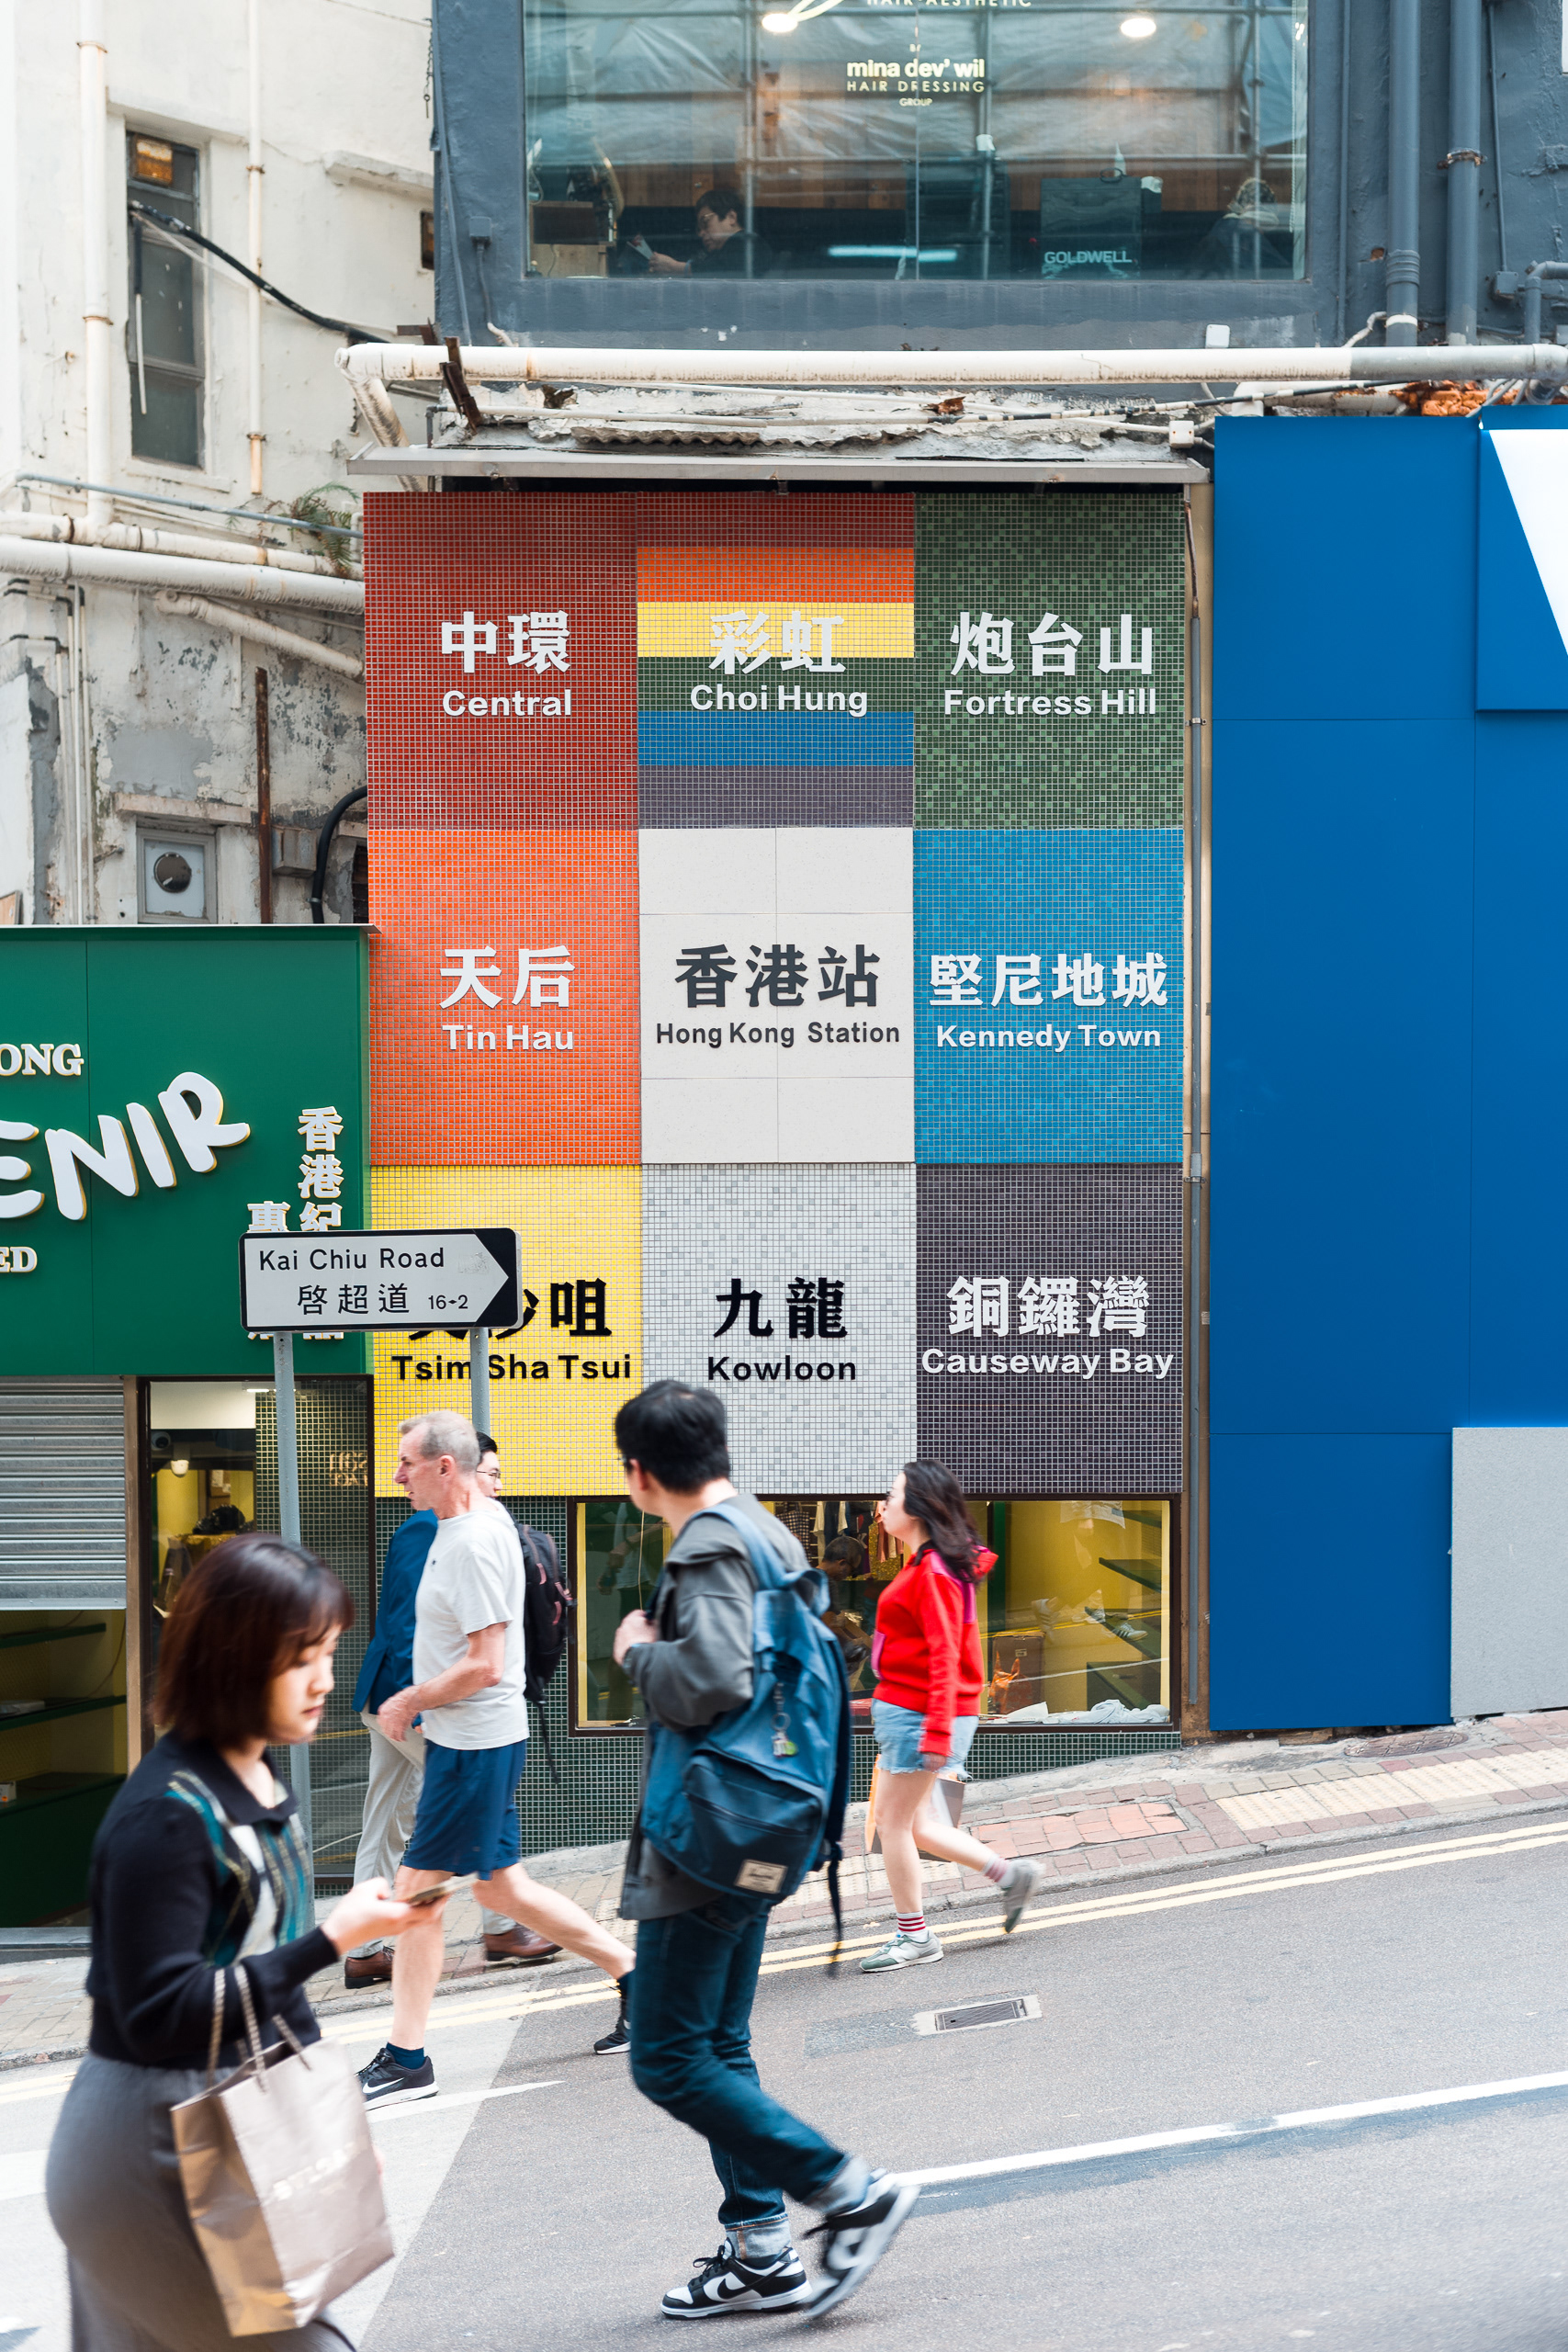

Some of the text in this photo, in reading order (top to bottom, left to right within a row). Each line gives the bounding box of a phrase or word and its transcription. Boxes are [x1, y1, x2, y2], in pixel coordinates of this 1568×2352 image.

[846, 59, 901, 78] mina
[953, 59, 986, 78] wil
[847, 81, 986, 93] HAIR DRESSING
[899, 98, 932, 107] GROUP
[1044, 250, 1133, 264] GOLDWELL
[441, 610, 570, 674] 中環
[709, 610, 846, 674] 彩虹
[950, 612, 1153, 676] 炮台山
[442, 689, 572, 717] Central
[690, 684, 868, 718] Choi Hung
[944, 688, 1156, 716] Fortress Hill
[439, 944, 576, 1010] 天后
[675, 944, 881, 1009] 香港站
[929, 953, 1168, 1008] 堅尼地城
[442, 1024, 574, 1050] Tin Hau
[657, 1021, 900, 1049] Hong Kong Station
[936, 1024, 1161, 1053] Kennedy Town
[259, 1247, 445, 1271] Kai Chiu Road
[713, 1276, 848, 1340] 九龍
[946, 1275, 1150, 1338] 銅鑼灣
[391, 1353, 631, 1380] Tsim Sha Tsui
[707, 1355, 856, 1381] Kowloon
[921, 1348, 1175, 1380] Causeway Bay
